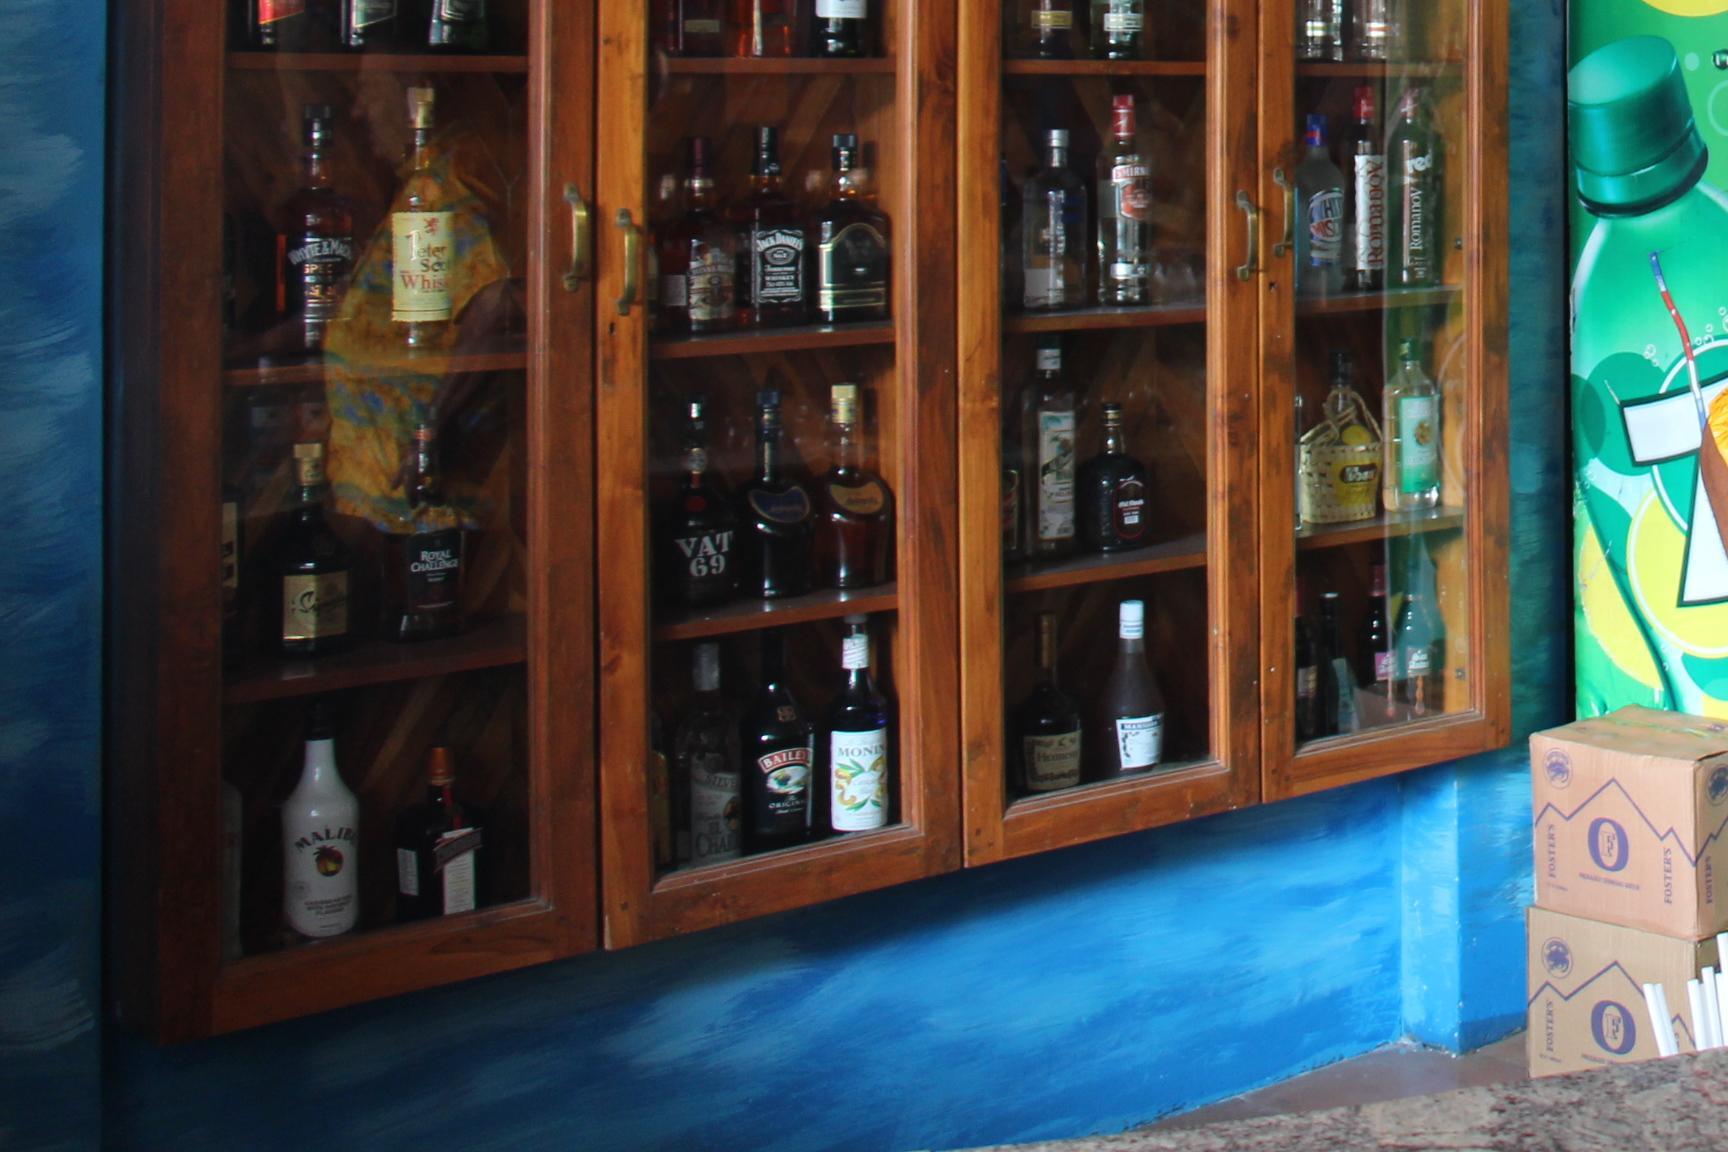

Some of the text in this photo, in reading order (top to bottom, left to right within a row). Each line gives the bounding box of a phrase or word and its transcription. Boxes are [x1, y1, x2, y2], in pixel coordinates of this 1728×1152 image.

[1367, 159, 1384, 265] Romanov
[1409, 186, 1424, 250] Romanov
[420, 550, 451, 562] ROYAL
[674, 530, 735, 559] VAT
[689, 554, 727, 577] 69
[1664, 847, 1673, 904] FOSTER'S
